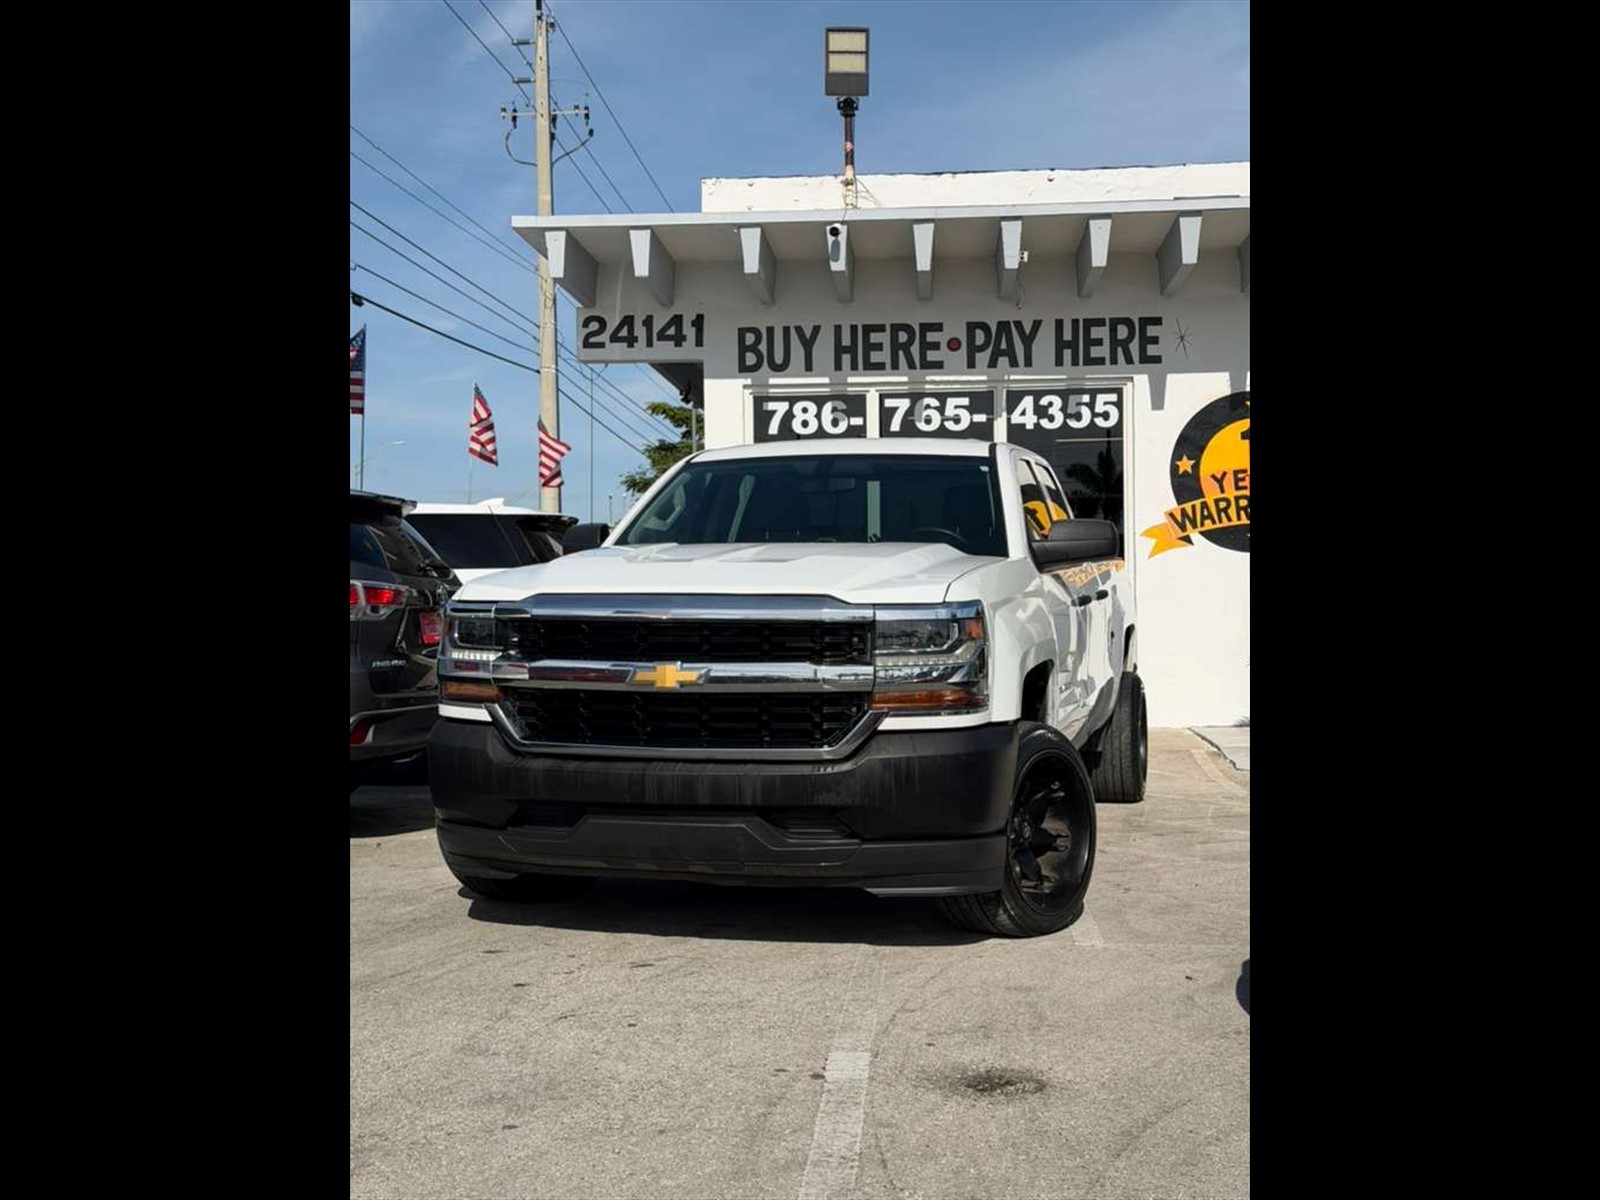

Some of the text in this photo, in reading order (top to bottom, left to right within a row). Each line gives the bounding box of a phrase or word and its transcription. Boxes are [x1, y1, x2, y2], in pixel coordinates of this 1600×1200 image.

[581, 313, 704, 349] 24141
[737, 316, 1163, 373] BUY HERE PAY HERE
[763, 393, 1120, 435] 786- 765- 4355
